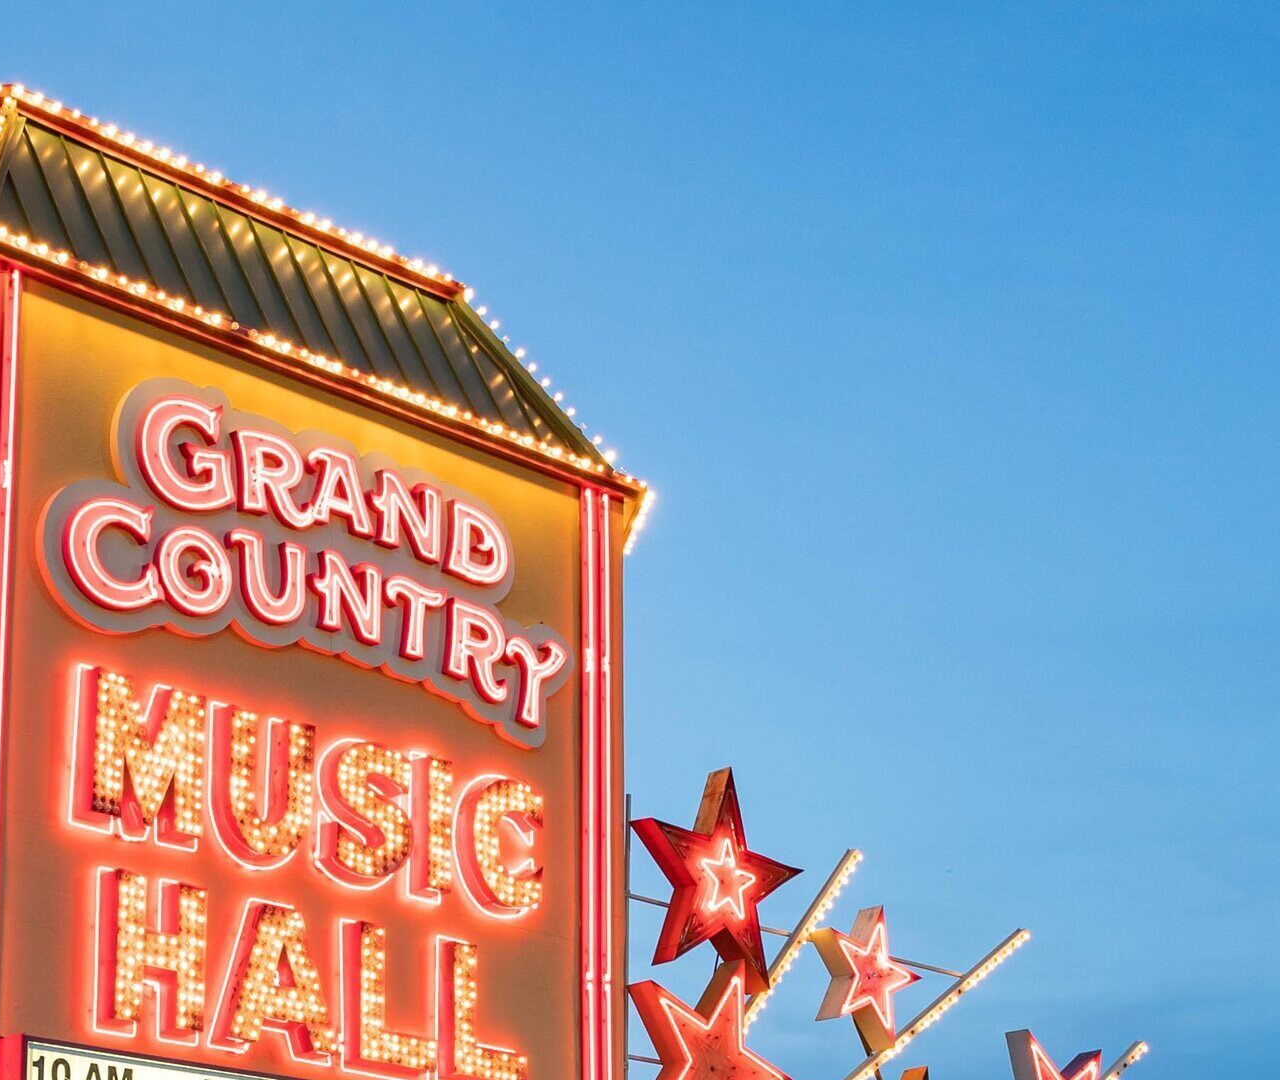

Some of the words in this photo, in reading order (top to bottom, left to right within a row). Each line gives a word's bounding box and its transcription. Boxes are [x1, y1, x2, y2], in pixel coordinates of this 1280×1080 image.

[136, 397, 509, 588] GRAND
[64, 496, 568, 729] COUNTRY
[67, 662, 545, 920] MUSIC
